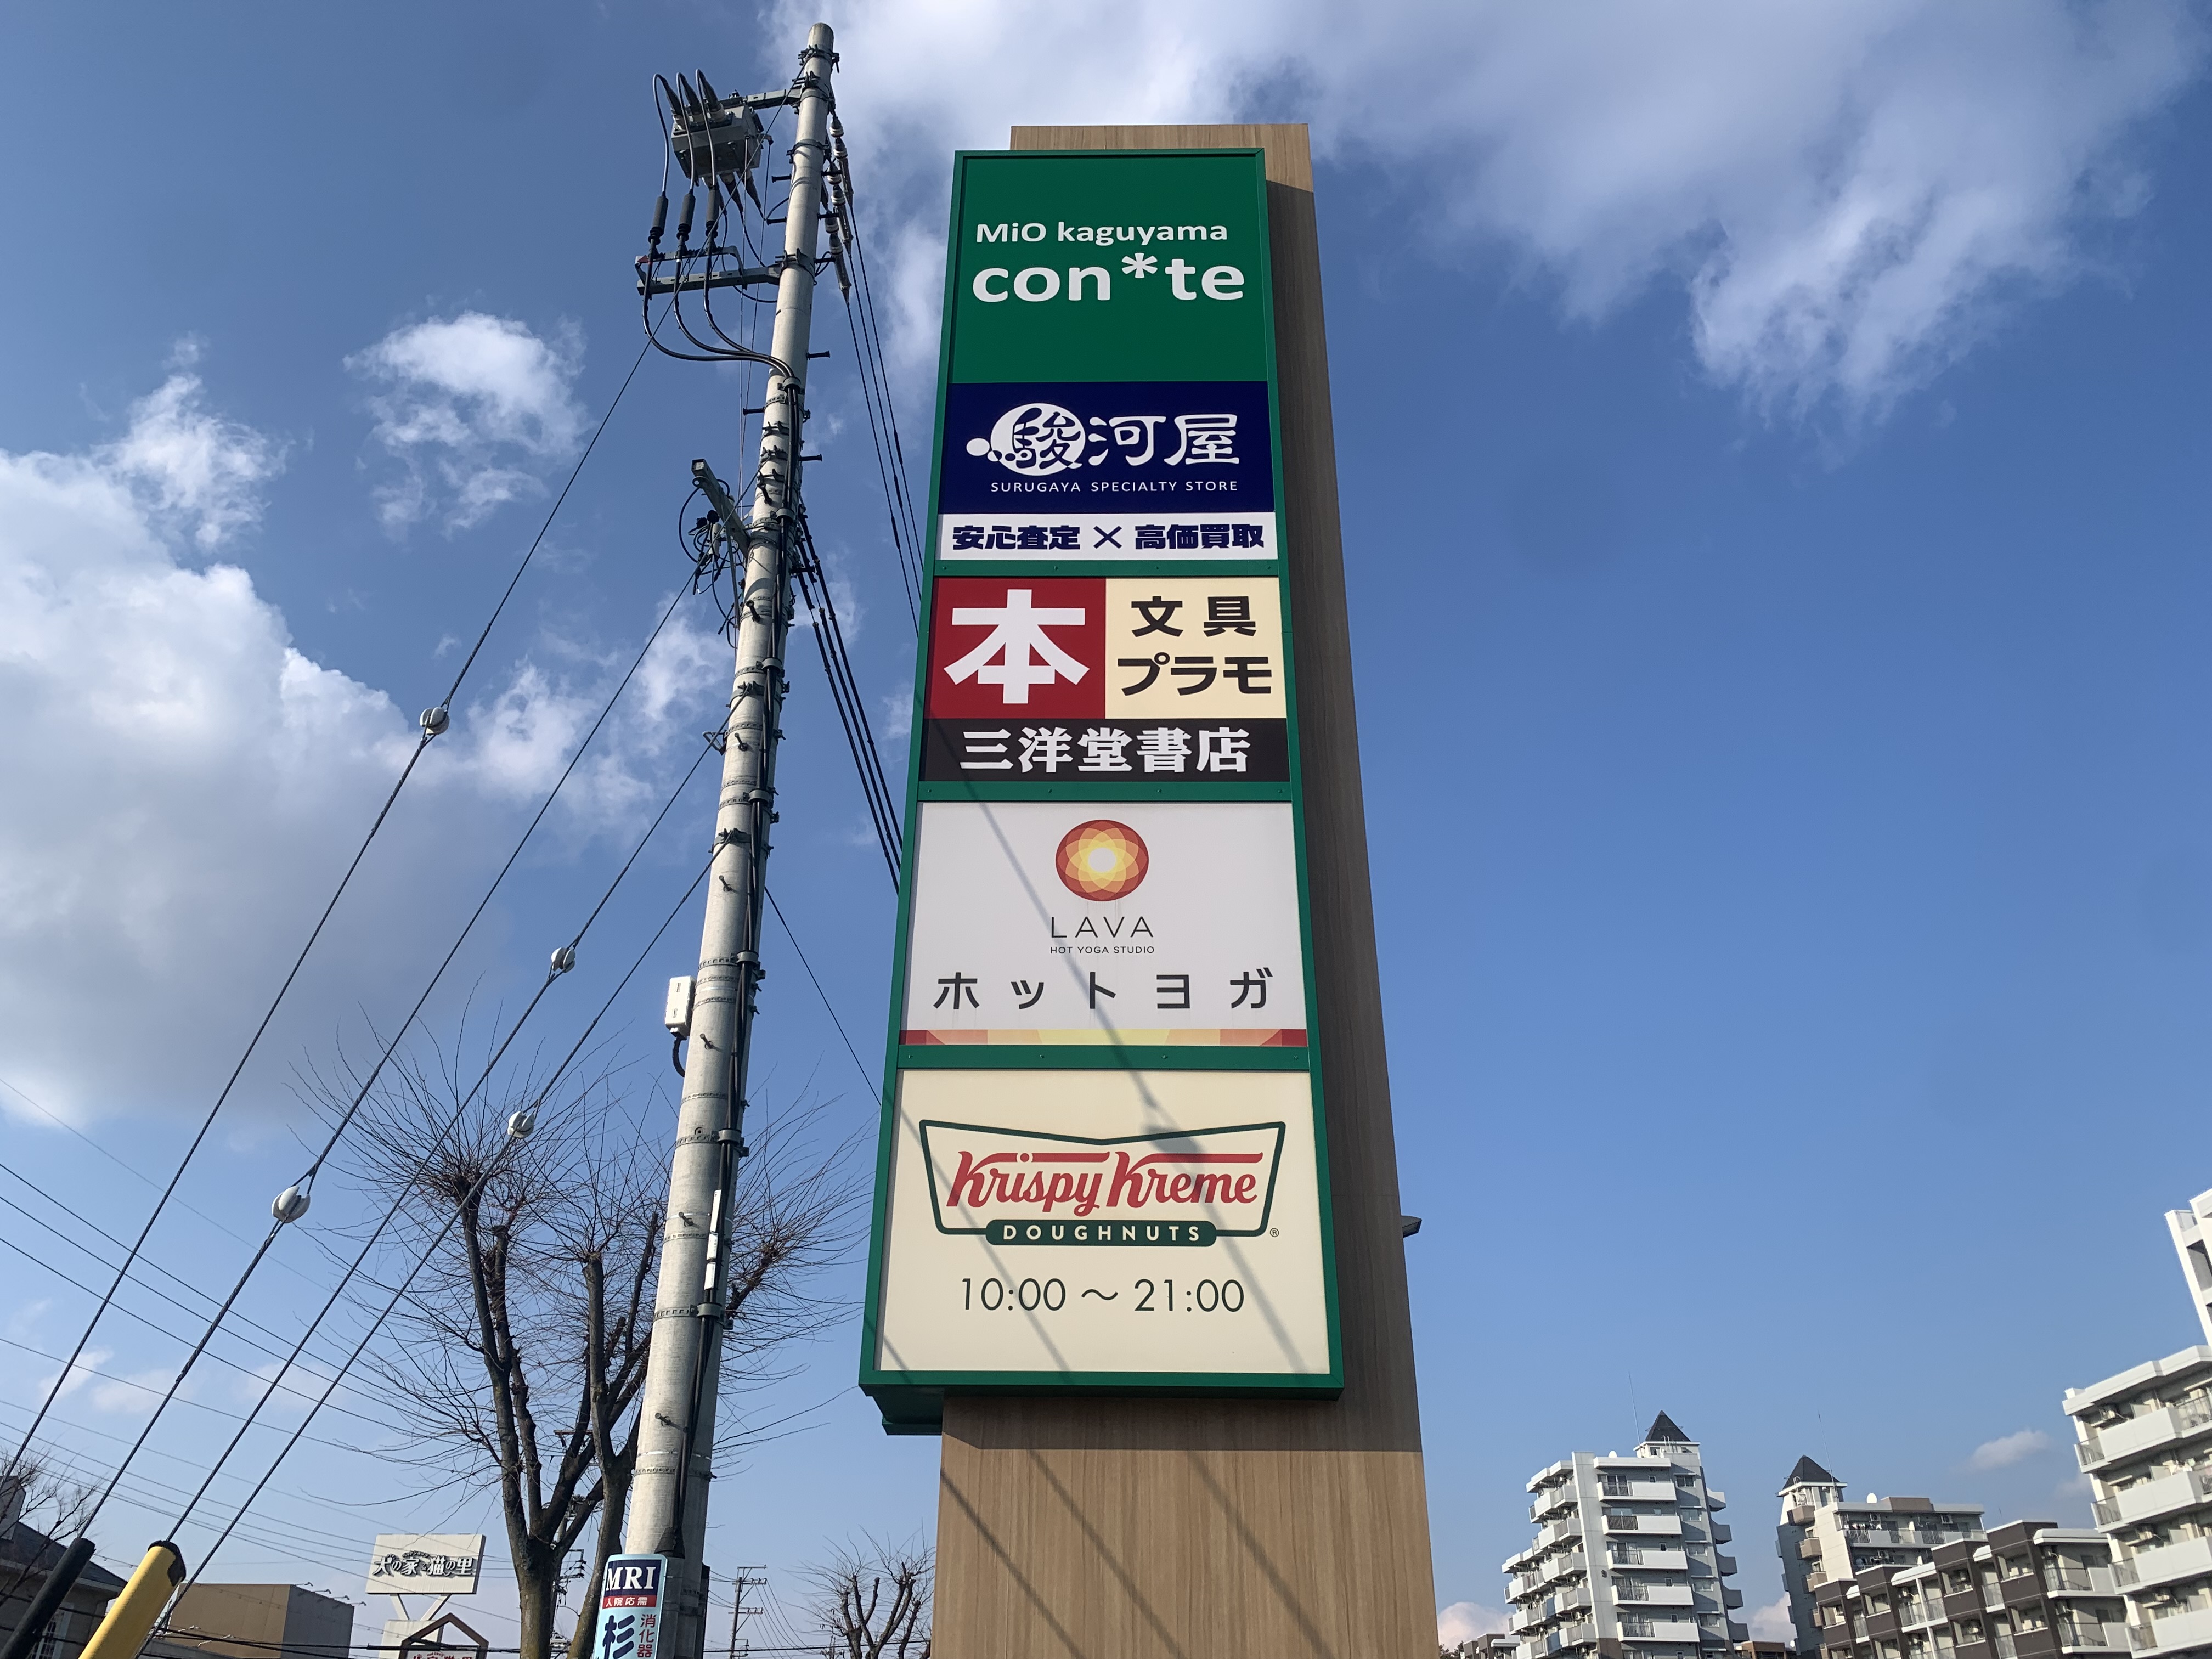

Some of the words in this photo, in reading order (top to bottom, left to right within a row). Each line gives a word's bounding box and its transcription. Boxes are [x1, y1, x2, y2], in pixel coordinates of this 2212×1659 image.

[977, 222, 1046, 242] MiO
[1058, 221, 1227, 246] kaguyama
[988, 403, 1240, 476] 駿河屋
[991, 482, 1081, 492] SURUGAYA
[1091, 481, 1177, 492] SPECIALTY
[1186, 481, 1238, 491] STORE
[952, 525, 1080, 550] 安心査定
[1135, 524, 1264, 550] 高価買取
[1131, 596, 1257, 637] 文具
[943, 589, 1090, 704] 本
[1118, 652, 1272, 696] プラモ
[960, 727, 1251, 773] 三洋堂書店
[1051, 916, 1154, 938] LAVA
[1077, 946, 1109, 954] YOGA
[1113, 946, 1155, 954] STUDIO
[933, 967, 1273, 1009] ホットヨガ
[946, 1151, 1110, 1217] Krispy
[1106, 1151, 1263, 1209] Kreme
[1003, 1224, 1200, 1242] DOUGHNUTS
[962, 1278, 1066, 1311] 10:00
[1134, 1279, 1244, 1312] 21:00
[605, 1566, 657, 1591] MRI
[636, 1613, 657, 1658] 消化器
